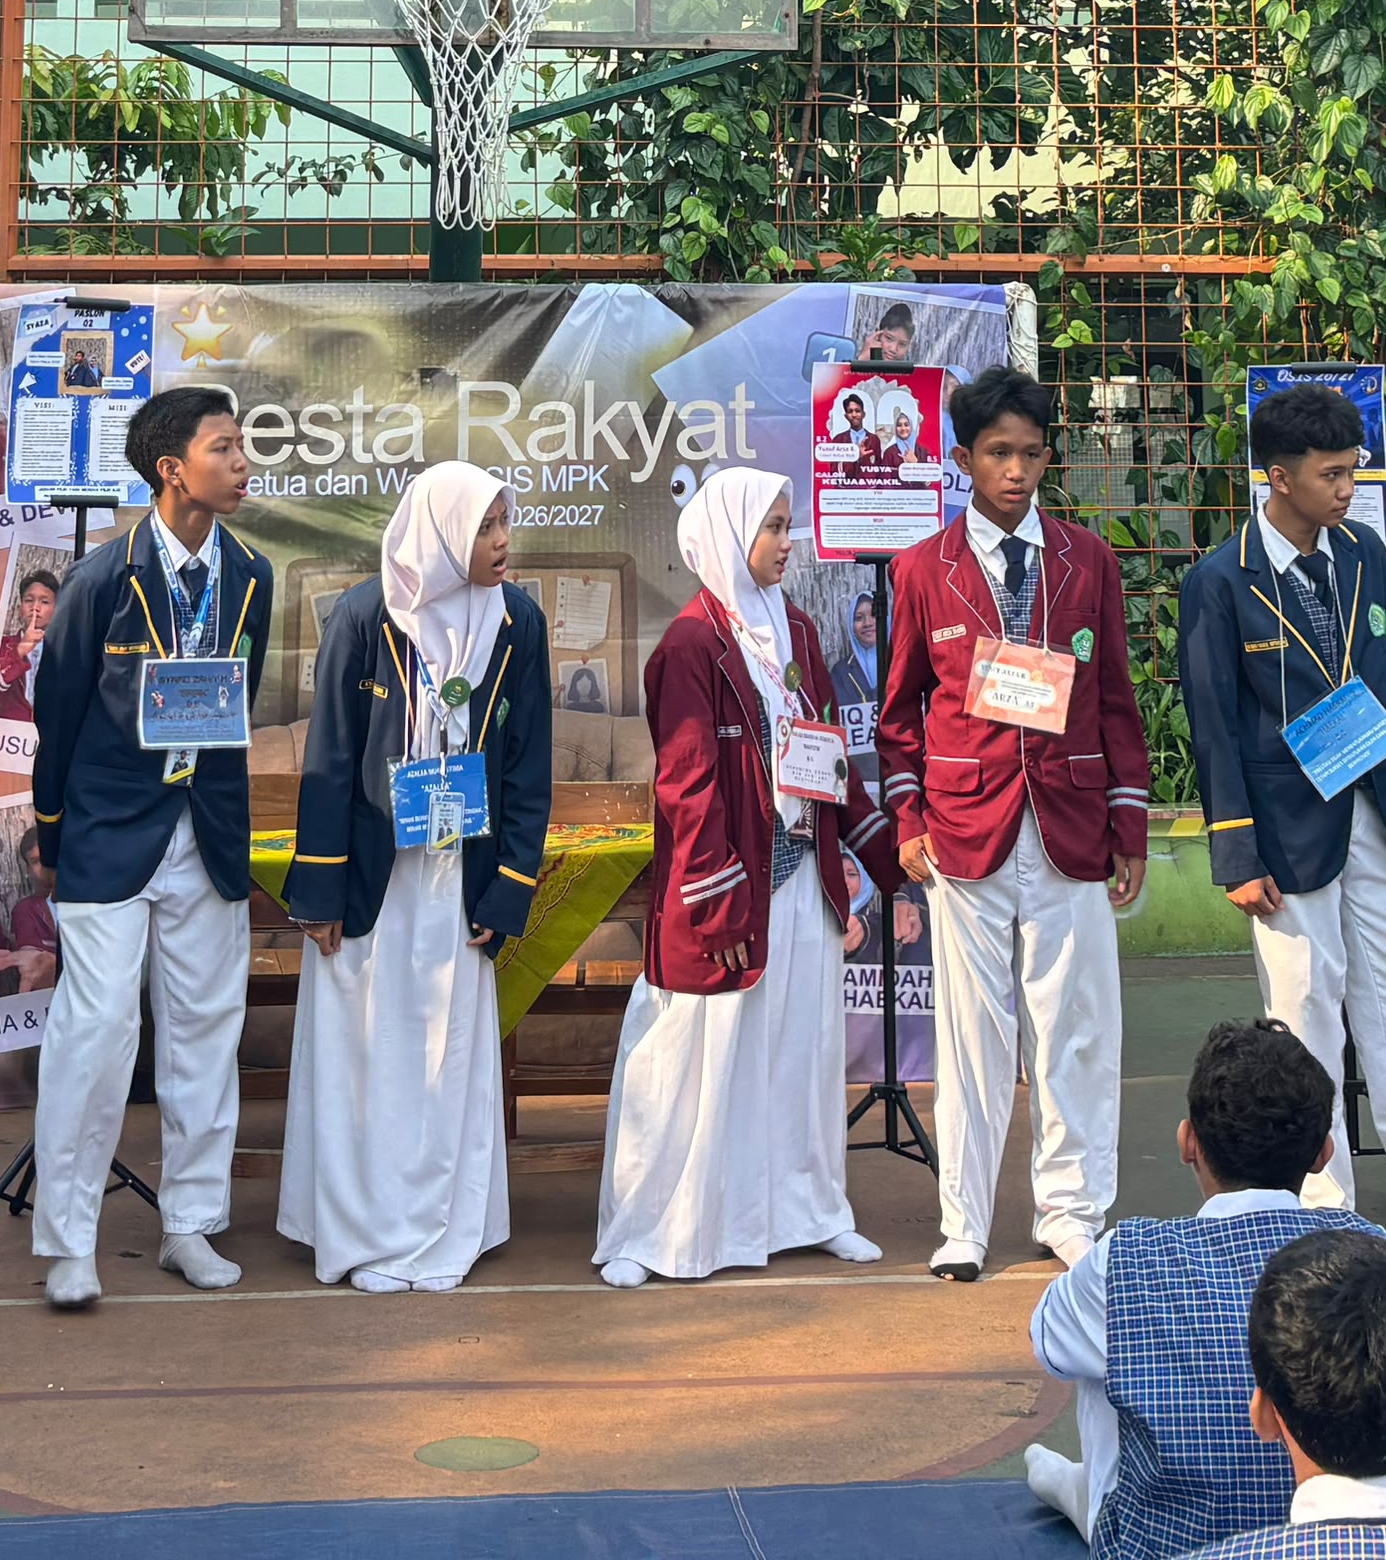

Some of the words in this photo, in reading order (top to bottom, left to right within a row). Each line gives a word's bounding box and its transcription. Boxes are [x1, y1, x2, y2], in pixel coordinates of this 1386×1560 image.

[457, 379, 758, 483] Rakyat
[245, 469, 304, 497] etua
[315, 468, 367, 496] dan
[542, 464, 611, 493] MPK
[513, 504, 605, 528] 026/2027
[24, 1009, 39, 1030] &
